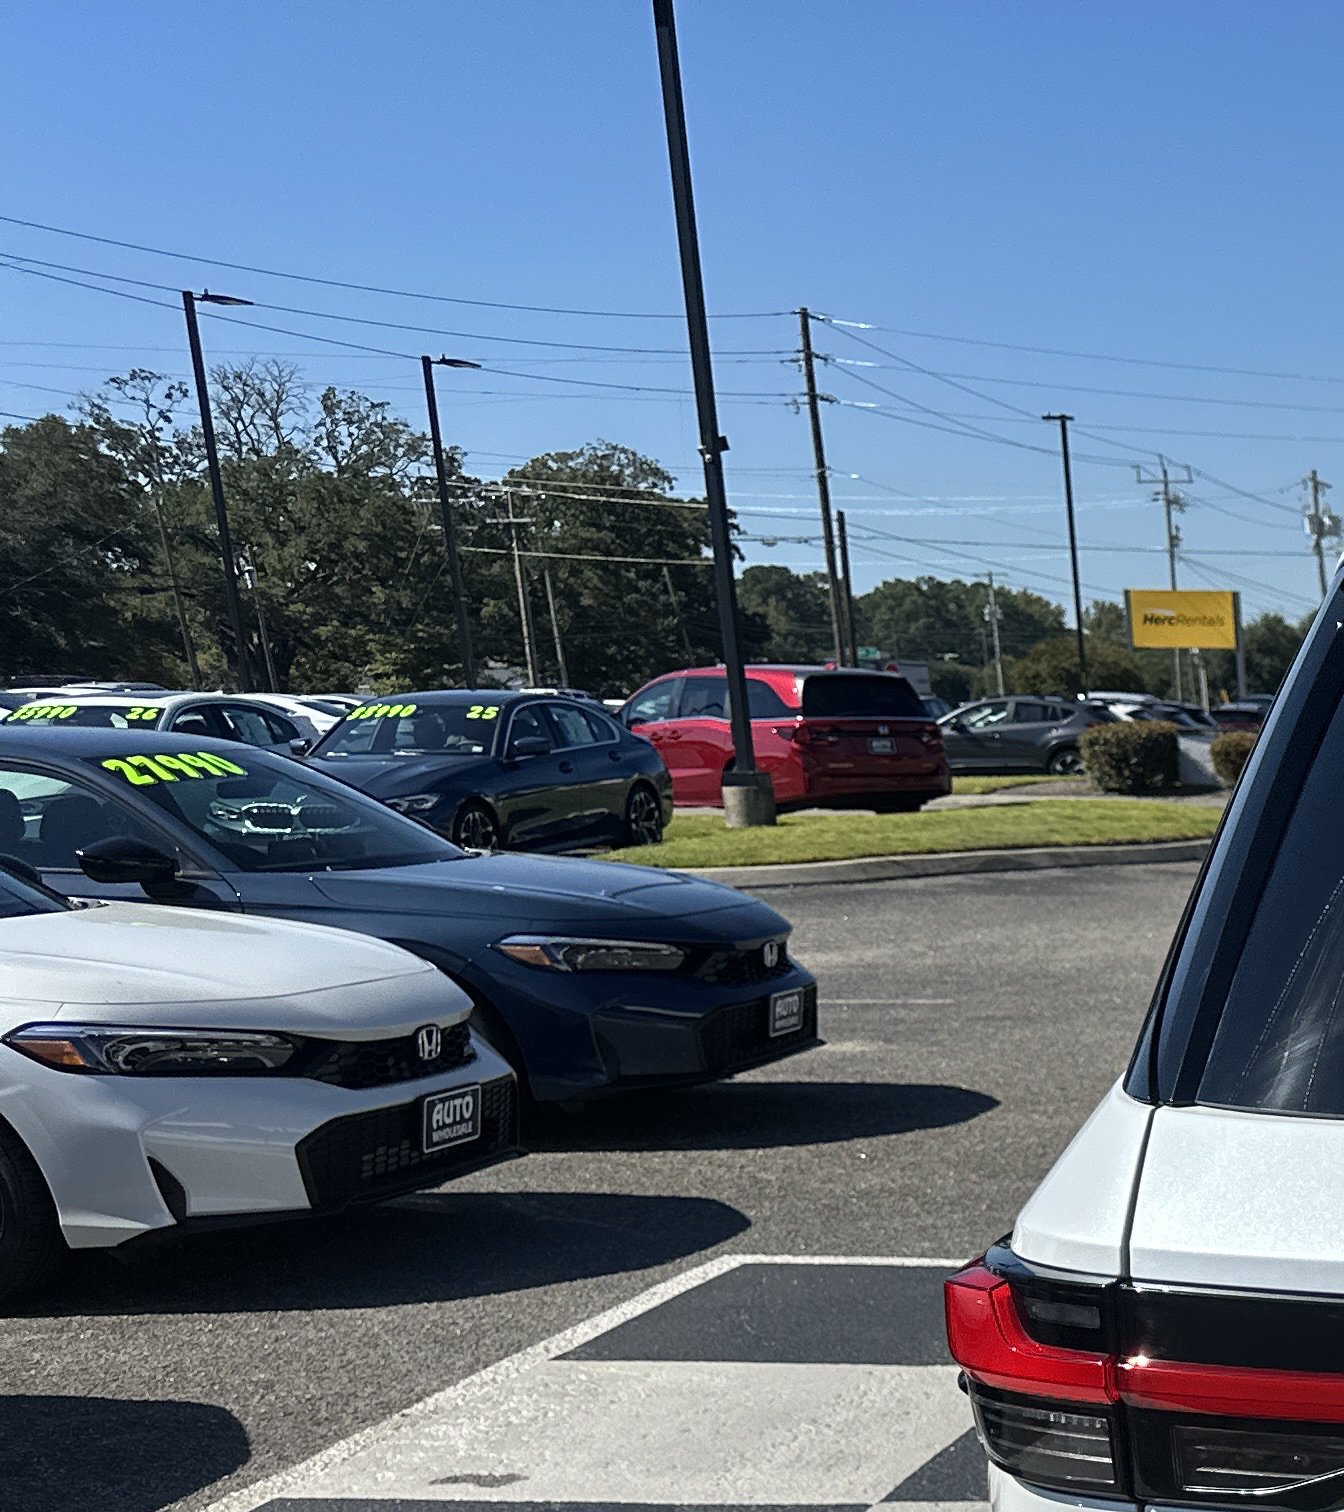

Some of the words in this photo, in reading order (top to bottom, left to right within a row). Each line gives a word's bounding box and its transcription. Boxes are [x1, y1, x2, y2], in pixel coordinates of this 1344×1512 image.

[1142, 612, 1226, 627] HercRentals
[125, 707, 159, 721] 26
[466, 705, 499, 720] 25
[101, 751, 249, 786] 27990
[432, 1095, 474, 1130] AUTO
